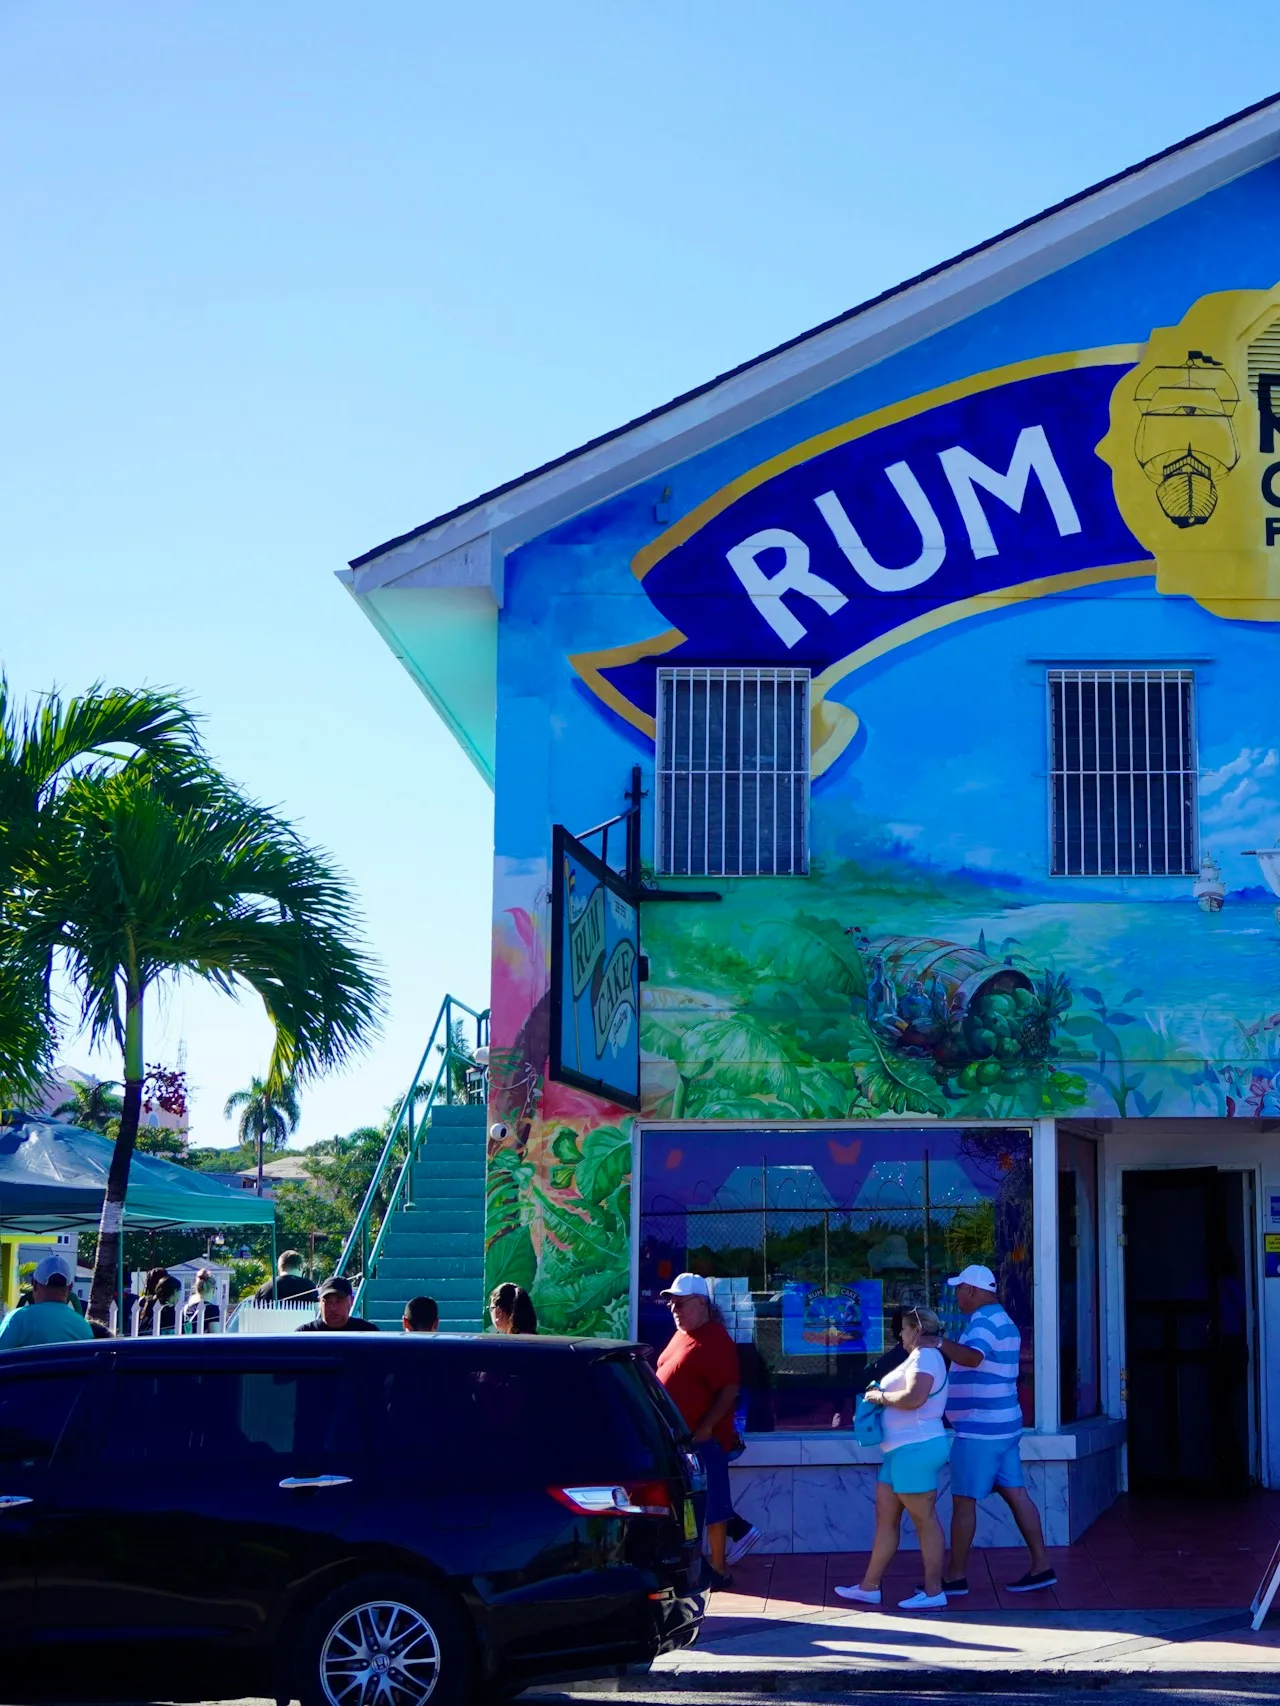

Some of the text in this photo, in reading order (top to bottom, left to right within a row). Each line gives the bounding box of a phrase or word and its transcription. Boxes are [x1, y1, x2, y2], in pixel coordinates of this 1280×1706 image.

[726, 424, 1082, 649] RUM
[574, 899, 600, 985] RUM
[598, 949, 630, 1035] CAKE
[807, 1289, 824, 1300] RUM
[840, 1288, 858, 1299] CAKE
